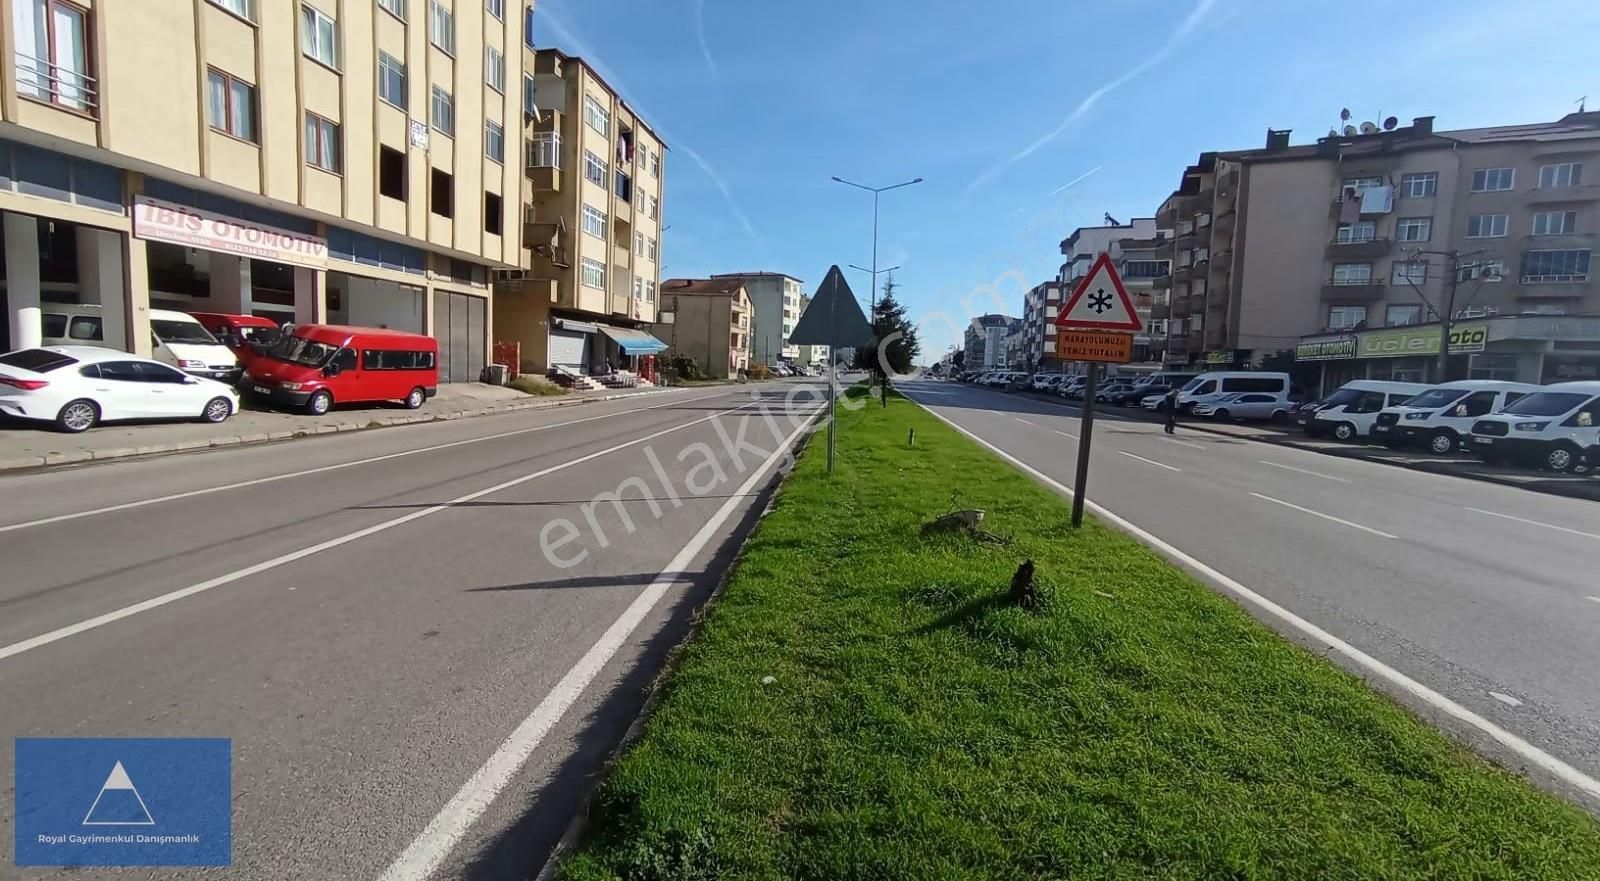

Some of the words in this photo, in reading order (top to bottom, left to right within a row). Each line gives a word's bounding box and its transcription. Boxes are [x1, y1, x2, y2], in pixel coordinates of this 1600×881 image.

[1065, 335, 1126, 345] KARAYOLUMUZU
[1449, 329, 1485, 345] oto
[1089, 348, 1125, 357] TUTALIM
